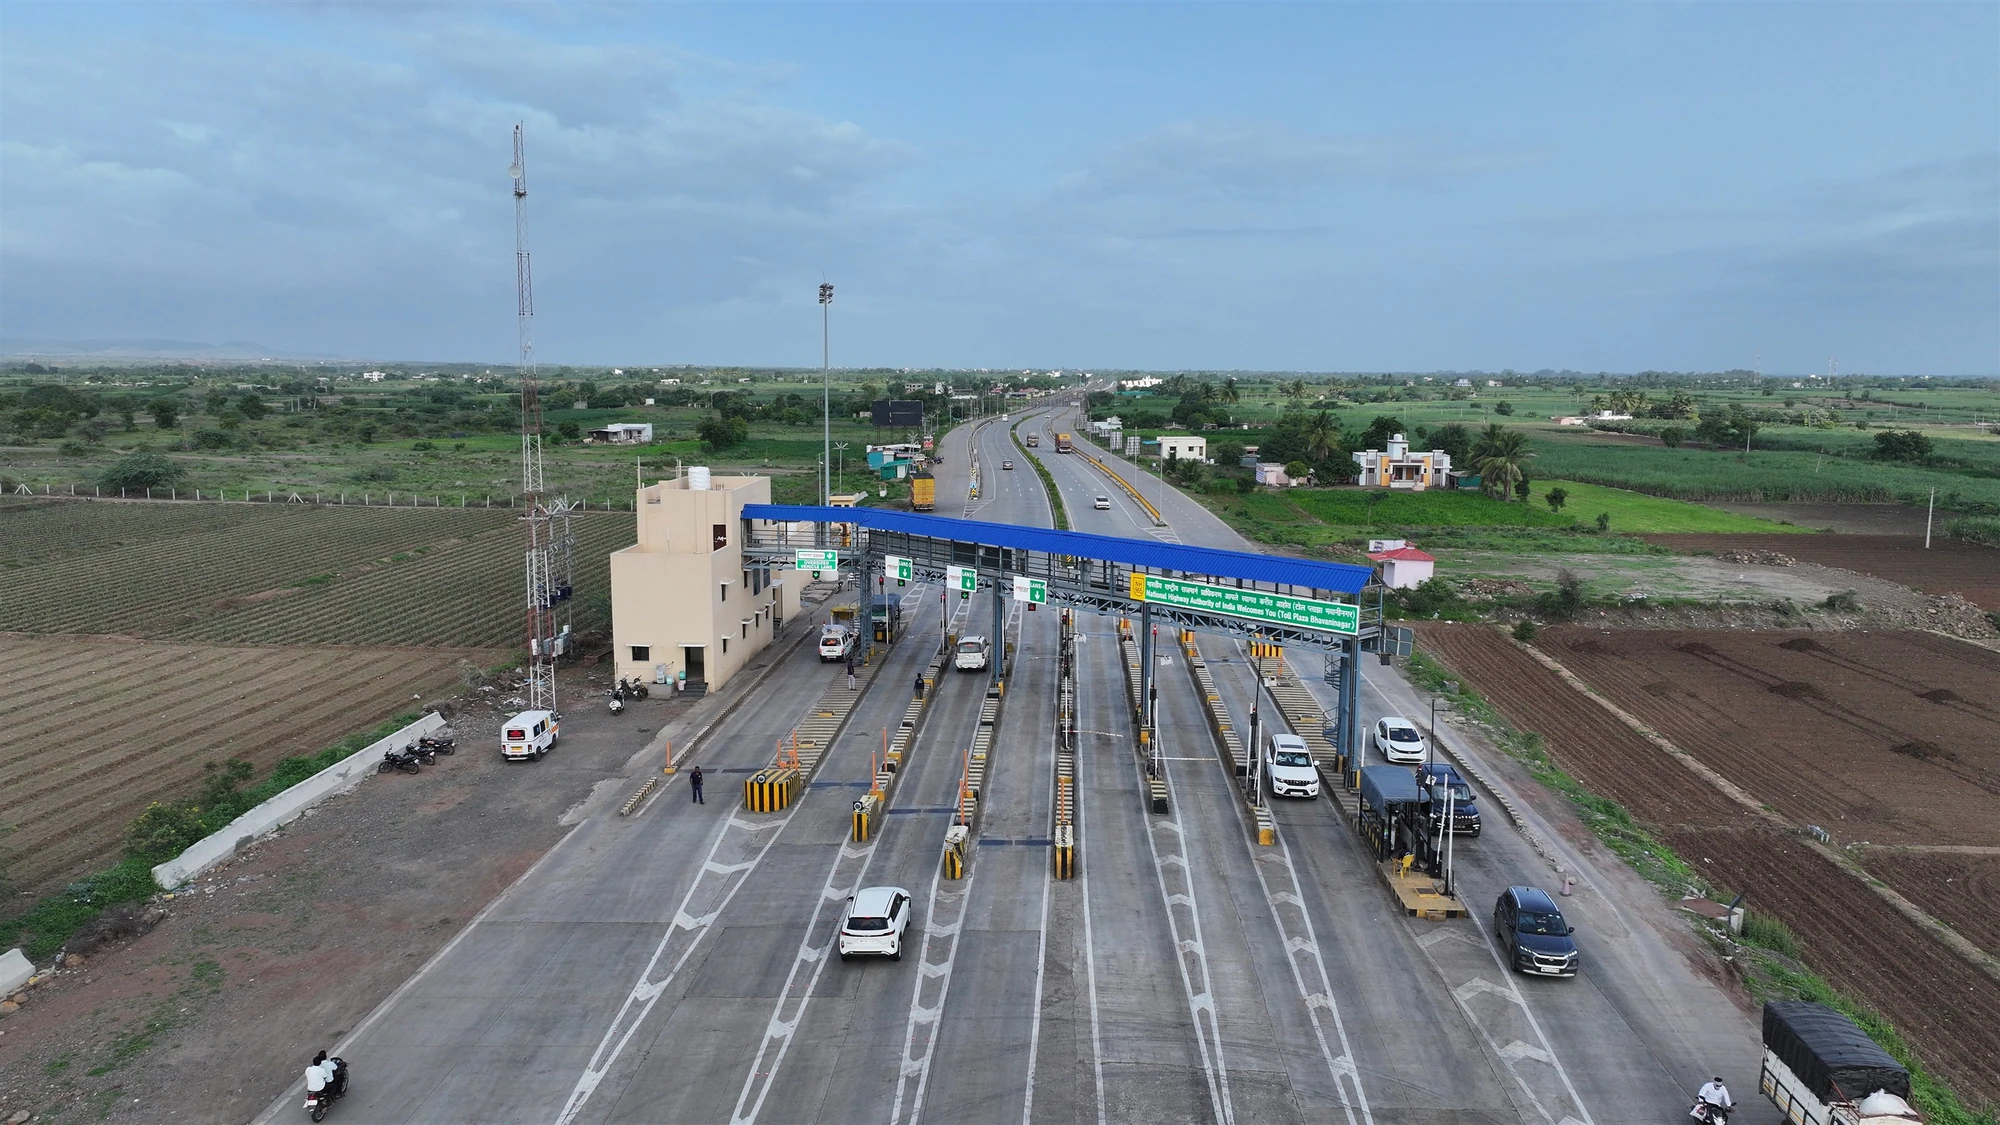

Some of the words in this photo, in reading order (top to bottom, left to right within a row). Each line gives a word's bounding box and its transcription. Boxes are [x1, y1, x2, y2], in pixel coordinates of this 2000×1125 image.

[1147, 580, 1162, 589] भारतीय
[1146, 590, 1166, 599] National
[1168, 594, 1189, 604] Highway
[1190, 597, 1214, 608] Authority
[1237, 604, 1264, 615] Welcomes
[1265, 609, 1276, 617] You
[1278, 610, 1291, 619] (Toll
[1293, 613, 1308, 622] Plaza
[1310, 615, 1354, 629] Bhavaninagar)
